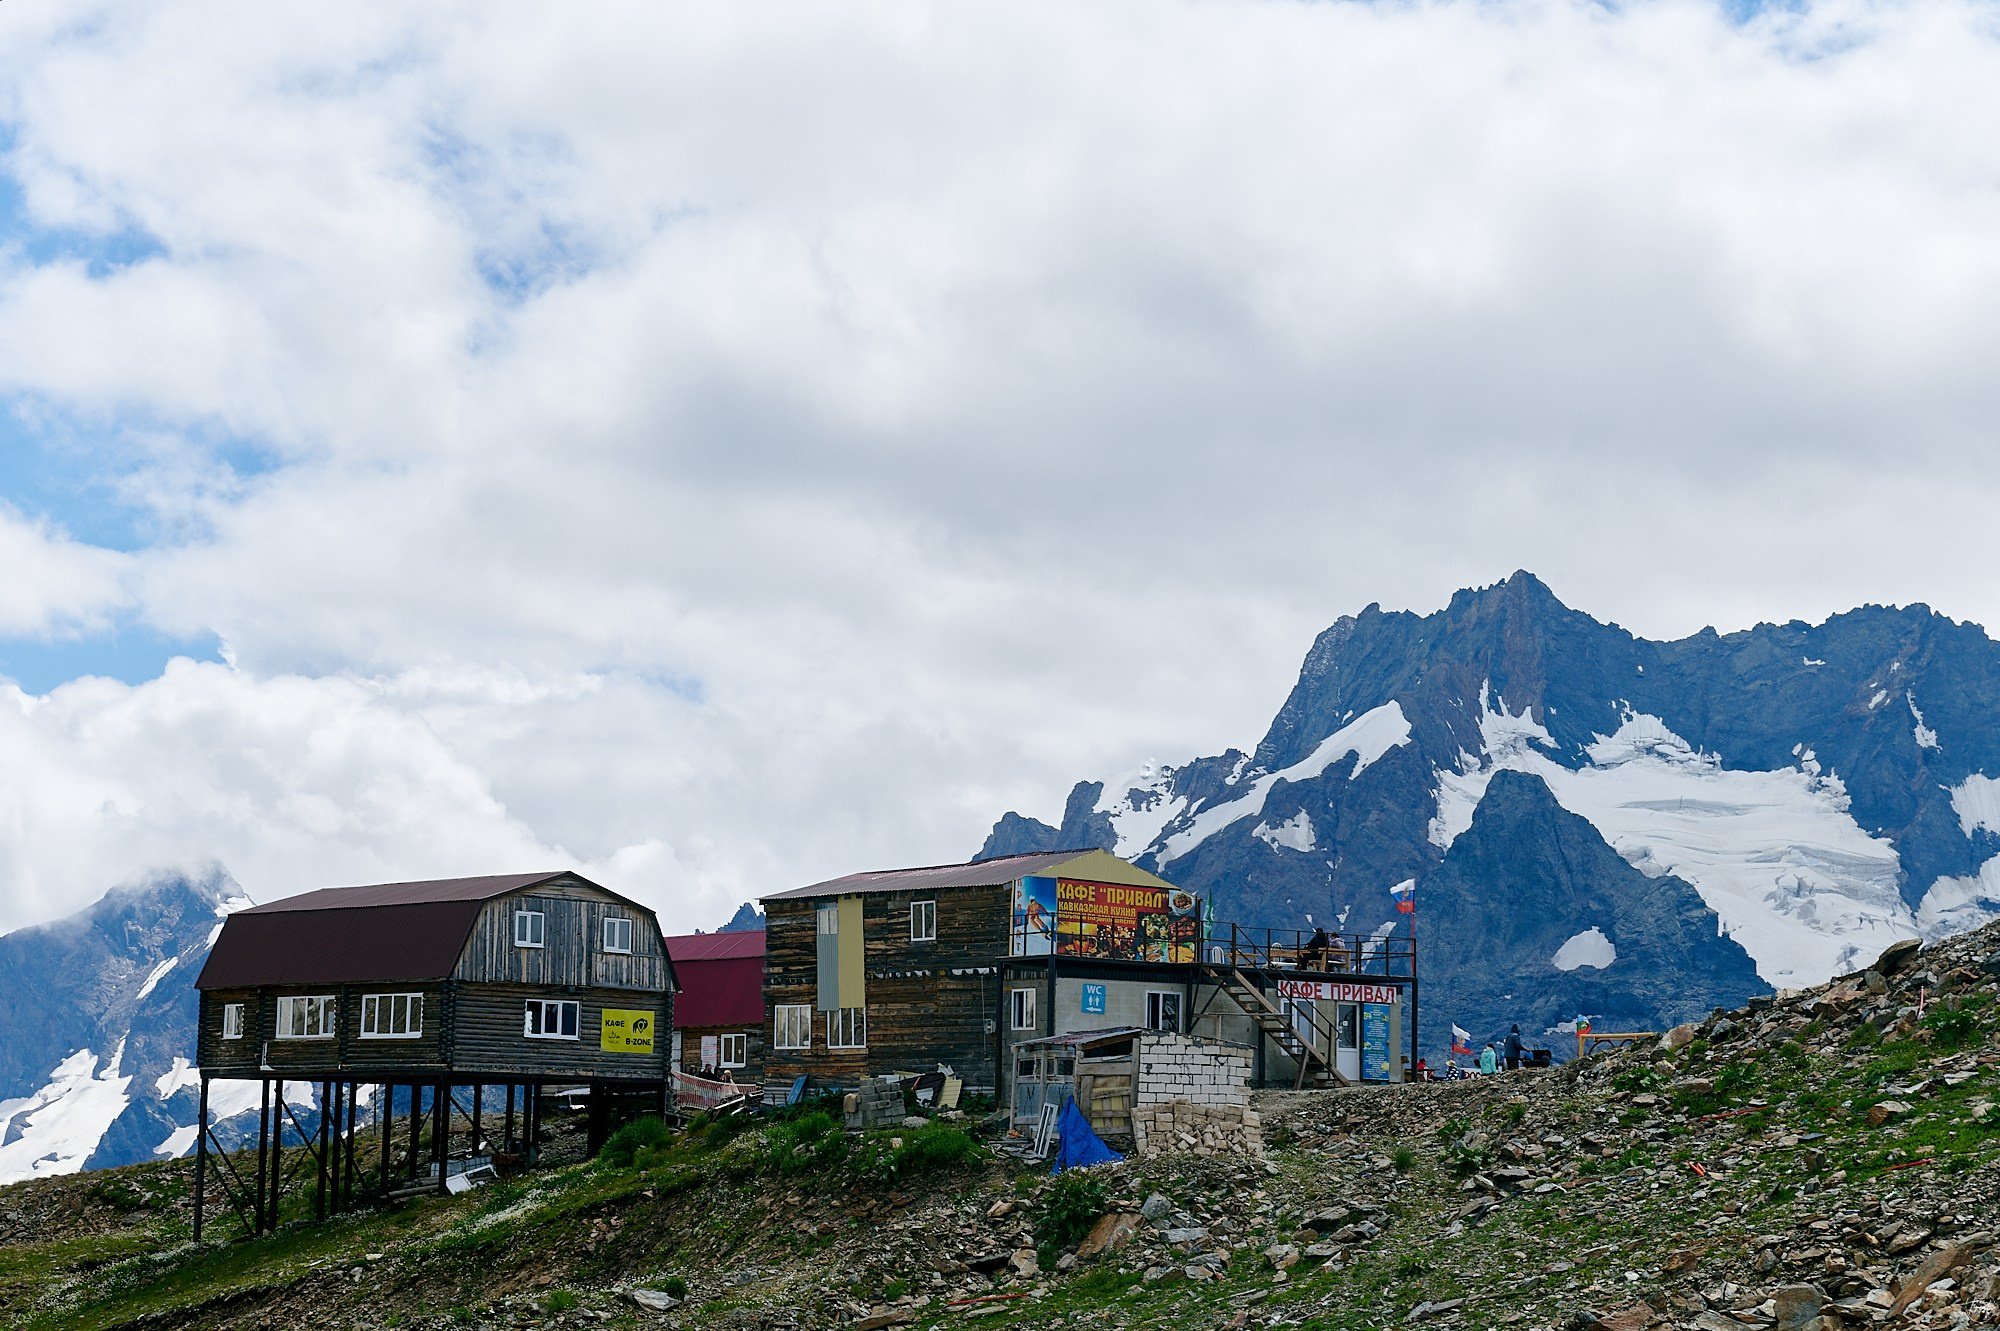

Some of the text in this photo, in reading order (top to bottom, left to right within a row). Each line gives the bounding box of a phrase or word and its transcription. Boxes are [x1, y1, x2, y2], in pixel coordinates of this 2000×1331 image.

[1057, 884, 1095, 902] КАФЕ
[1058, 901, 1136, 918] КАВКАЗСКАЯ КУХНЯ
[1086, 984, 1102, 995] WC
[1280, 981, 1395, 1003] КАФЕ ПРИВАЛ
[626, 1038, 651, 1046] B-ZONE
